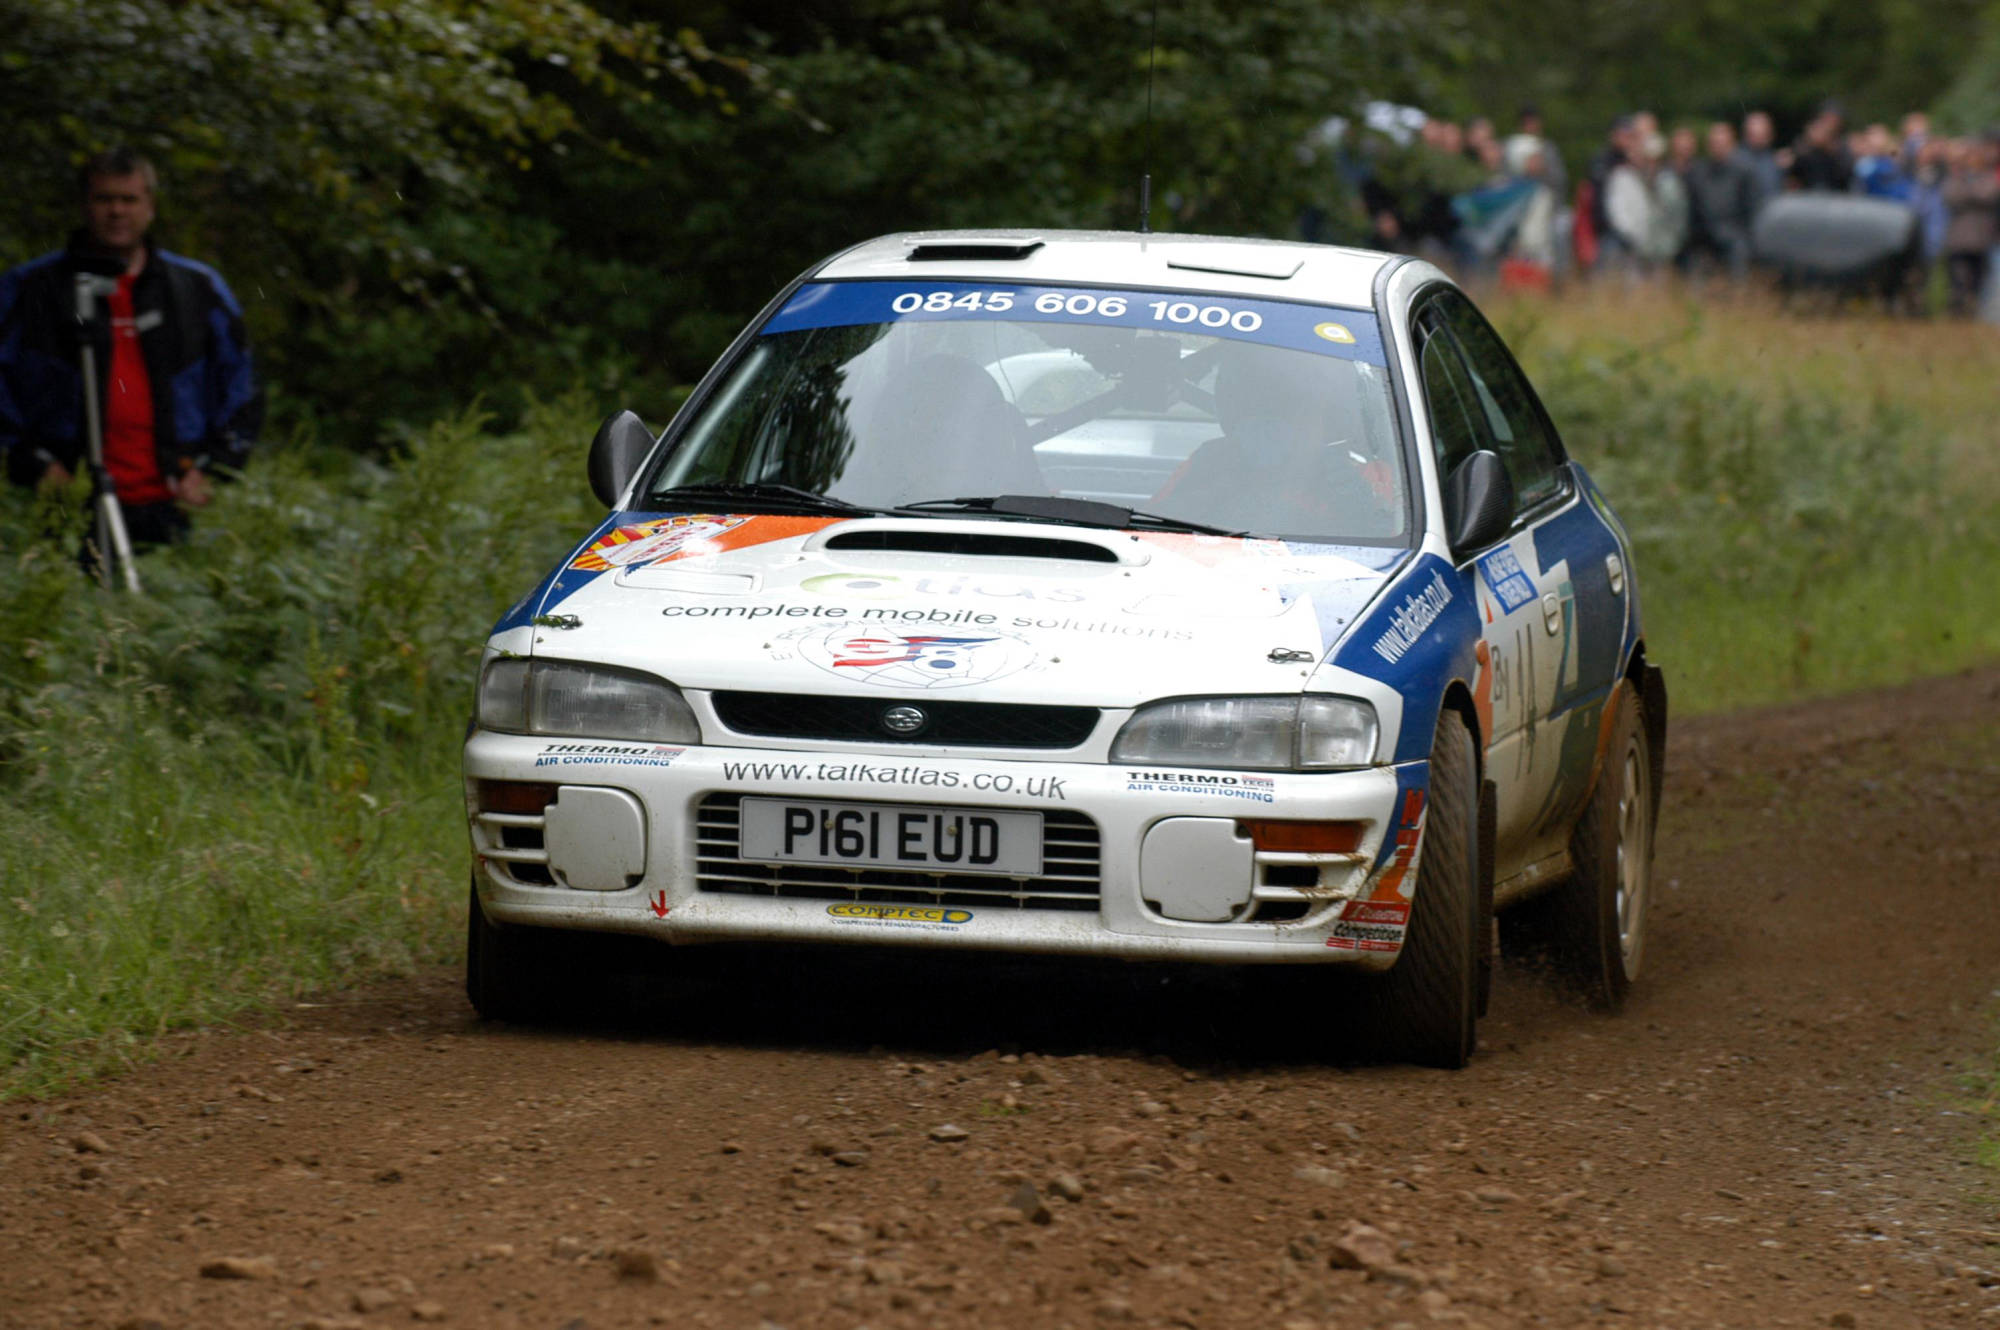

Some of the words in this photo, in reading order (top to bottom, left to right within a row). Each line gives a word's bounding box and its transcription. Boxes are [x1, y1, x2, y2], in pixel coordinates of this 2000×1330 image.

[891, 291, 1015, 314] 0845
[1034, 293, 1128, 318] 606
[1149, 300, 1263, 333] 1000
[662, 604, 848, 620] complete
[862, 607, 998, 625] mobile
[1012, 617, 1194, 641] solutions
[545, 744, 648, 755] THERMO
[535, 757, 559, 767] AIR
[563, 756, 670, 767] CONDITIONING
[723, 762, 1068, 801] www.talkatlas.co.uk
[1127, 772, 1238, 785] THERMO
[1242, 779, 1275, 788] TECH
[1127, 783, 1153, 791] AIR
[1159, 784, 1274, 803] CONDITIONING
[784, 806, 880, 860] P161
[897, 812, 999, 865] EUD
[832, 904, 940, 920] COMPTEC
[1334, 922, 1402, 942] Competition
